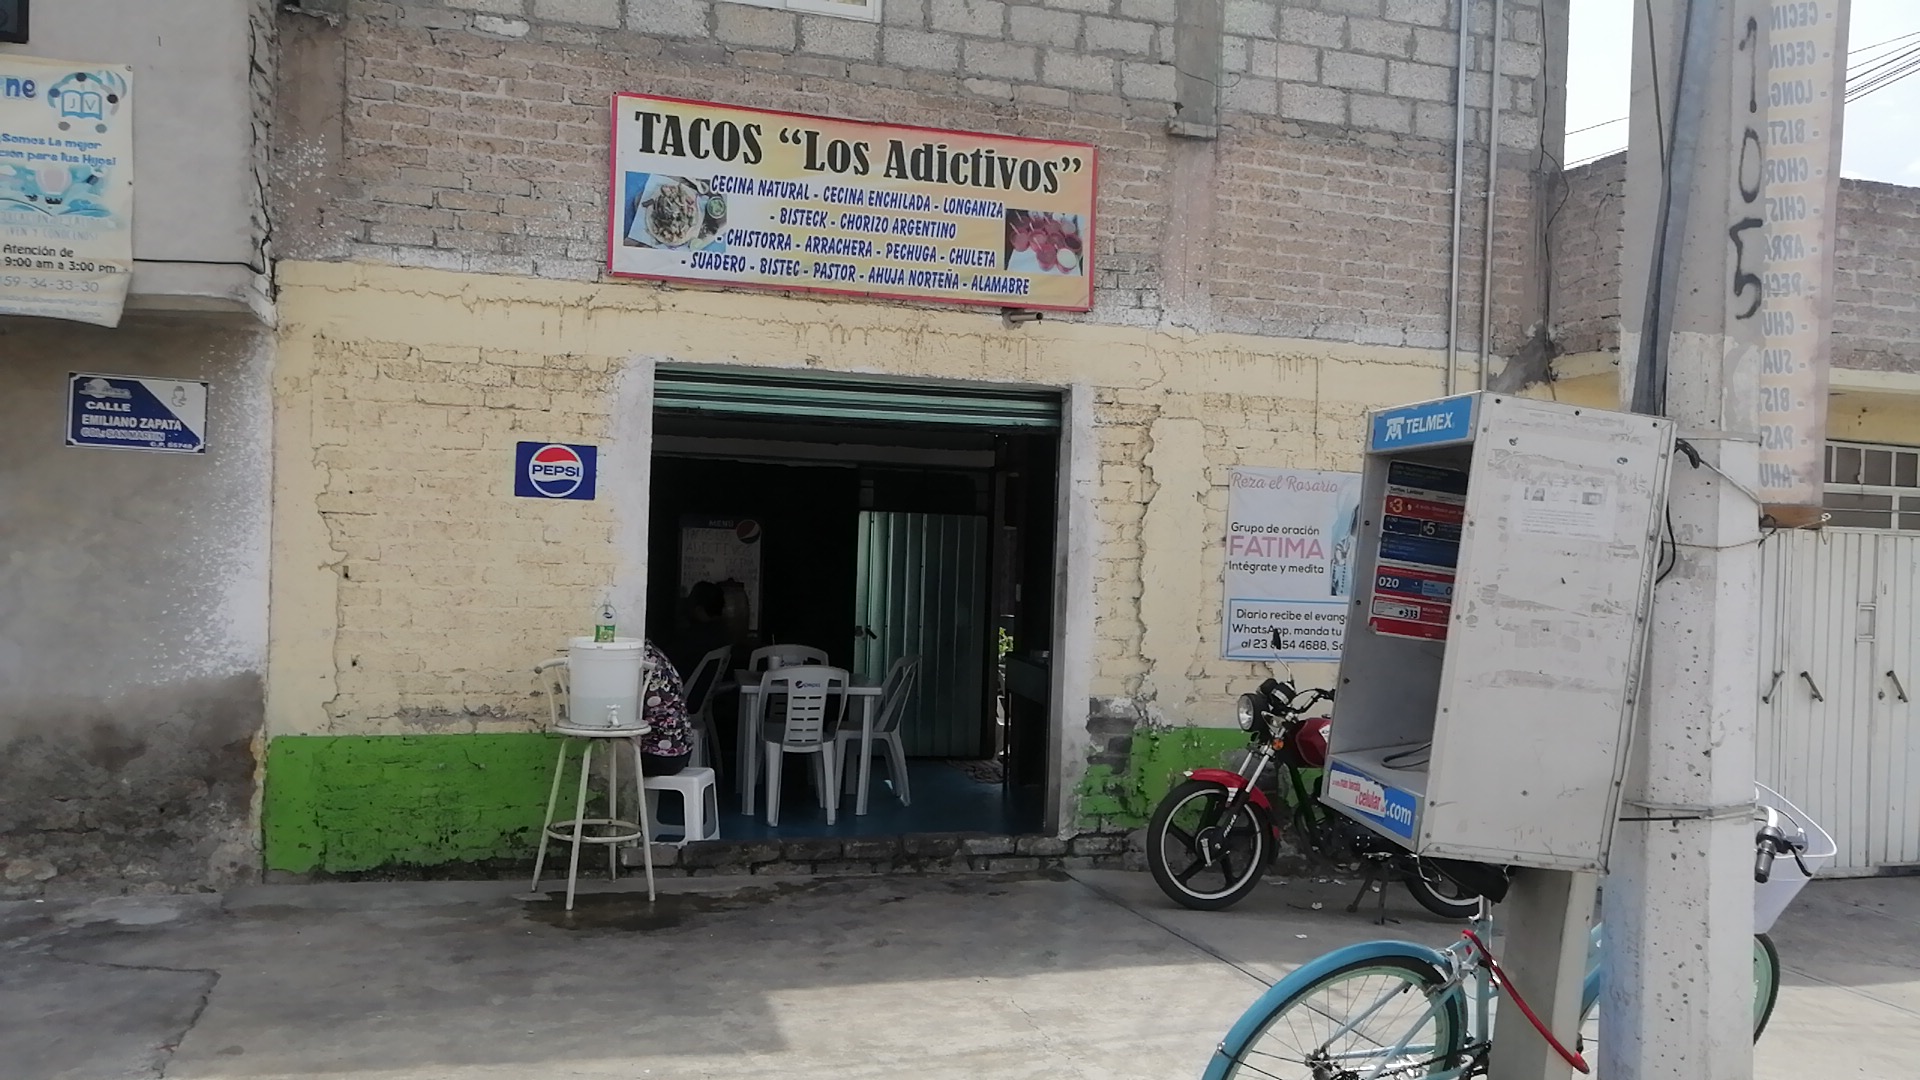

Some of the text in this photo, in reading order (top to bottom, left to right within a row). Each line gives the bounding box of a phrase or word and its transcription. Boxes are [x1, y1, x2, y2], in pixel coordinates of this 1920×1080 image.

[85, 99, 97, 111] V
[635, 111, 762, 165] TACOS
[711, 174, 754, 195] CECINA
[757, 180, 810, 201] NATURAL
[823, 186, 864, 206] CECINA
[868, 190, 931, 212] ENCHILADA
[943, 197, 1004, 219] LONGANIZA
[779, 207, 827, 228] BISTECK
[840, 212, 889, 233] CHORIZO
[892, 217, 957, 239] ARGENTINO
[3, 244, 74, 258] Atención de
[727, 228, 792, 251] CHISTORRA
[805, 235, 873, 257] ARRACHERA
[885, 242, 937, 263] PECHUGA
[949, 248, 996, 268] CHULETA
[4, 256, 32, 268] 9:00
[36, 261, 54, 269] am
[69, 261, 95, 272] 3:00
[98, 265, 116, 274] pm
[690, 251, 746, 273] SUADERO
[759, 257, 800, 277] BISTEC
[813, 261, 856, 283] PASTOR
[868, 266, 905, 286] AHUJA
[908, 268, 959, 290] NORTEÑA
[971, 273, 1030, 295] ALAMABRE
[85, 401, 132, 412] CALLE
[81, 414, 182, 431] EMILIANO ZAPATA
[1406, 411, 1454, 434] TELMEX
[106, 429, 129, 439] SAN
[532, 464, 580, 477] PEPSI
[1230, 472, 1338, 493] Reza el Rosario
[1231, 522, 1320, 535] Grupo de oración
[1229, 535, 1325, 560] FATIMA
[1228, 560, 1324, 574] Intégrate y medita
[1378, 576, 1400, 589] 020
[1236, 608, 1268, 619] Diario
[1270, 609, 1302, 621] recibe
[1304, 610, 1313, 621] el
[1293, 625, 1329, 636] manda
[1331, 627, 1342, 636] tu
[1241, 638, 1251, 648] al
[1252, 638, 1268, 649] 23
